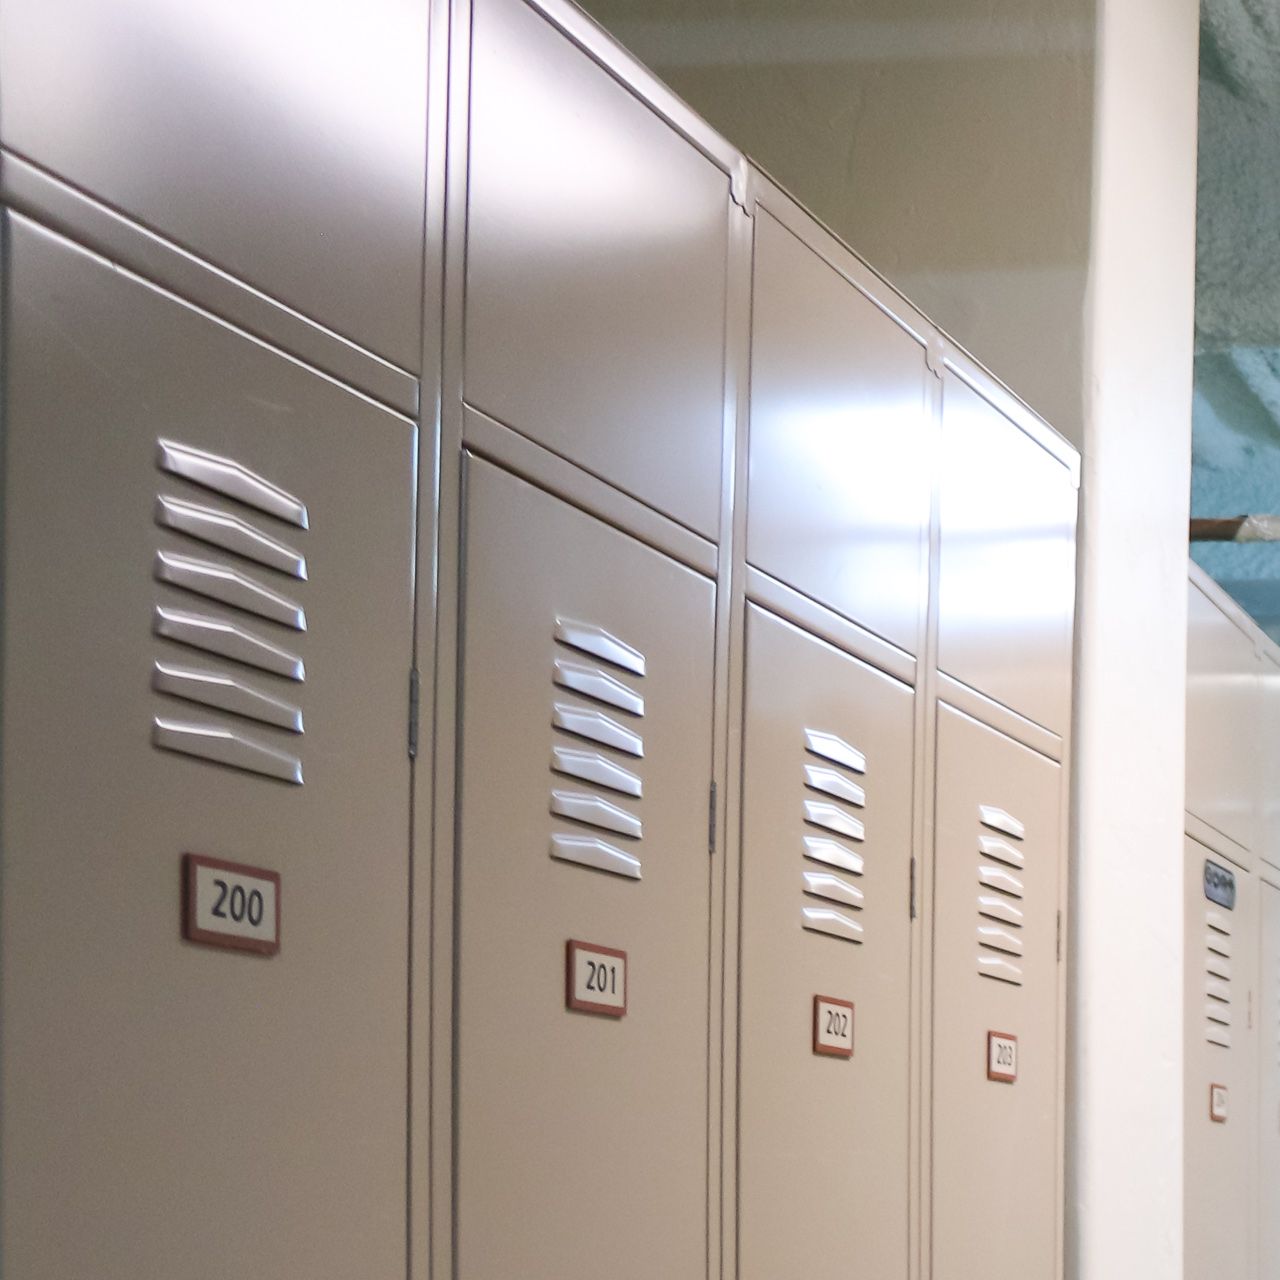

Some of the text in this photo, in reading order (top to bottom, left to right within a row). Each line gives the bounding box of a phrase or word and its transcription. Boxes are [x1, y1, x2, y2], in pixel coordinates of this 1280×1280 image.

[212, 878, 264, 927] 200
[586, 960, 617, 995] 201
[826, 1010, 848, 1038] 202
[996, 1043, 1013, 1066] 203
